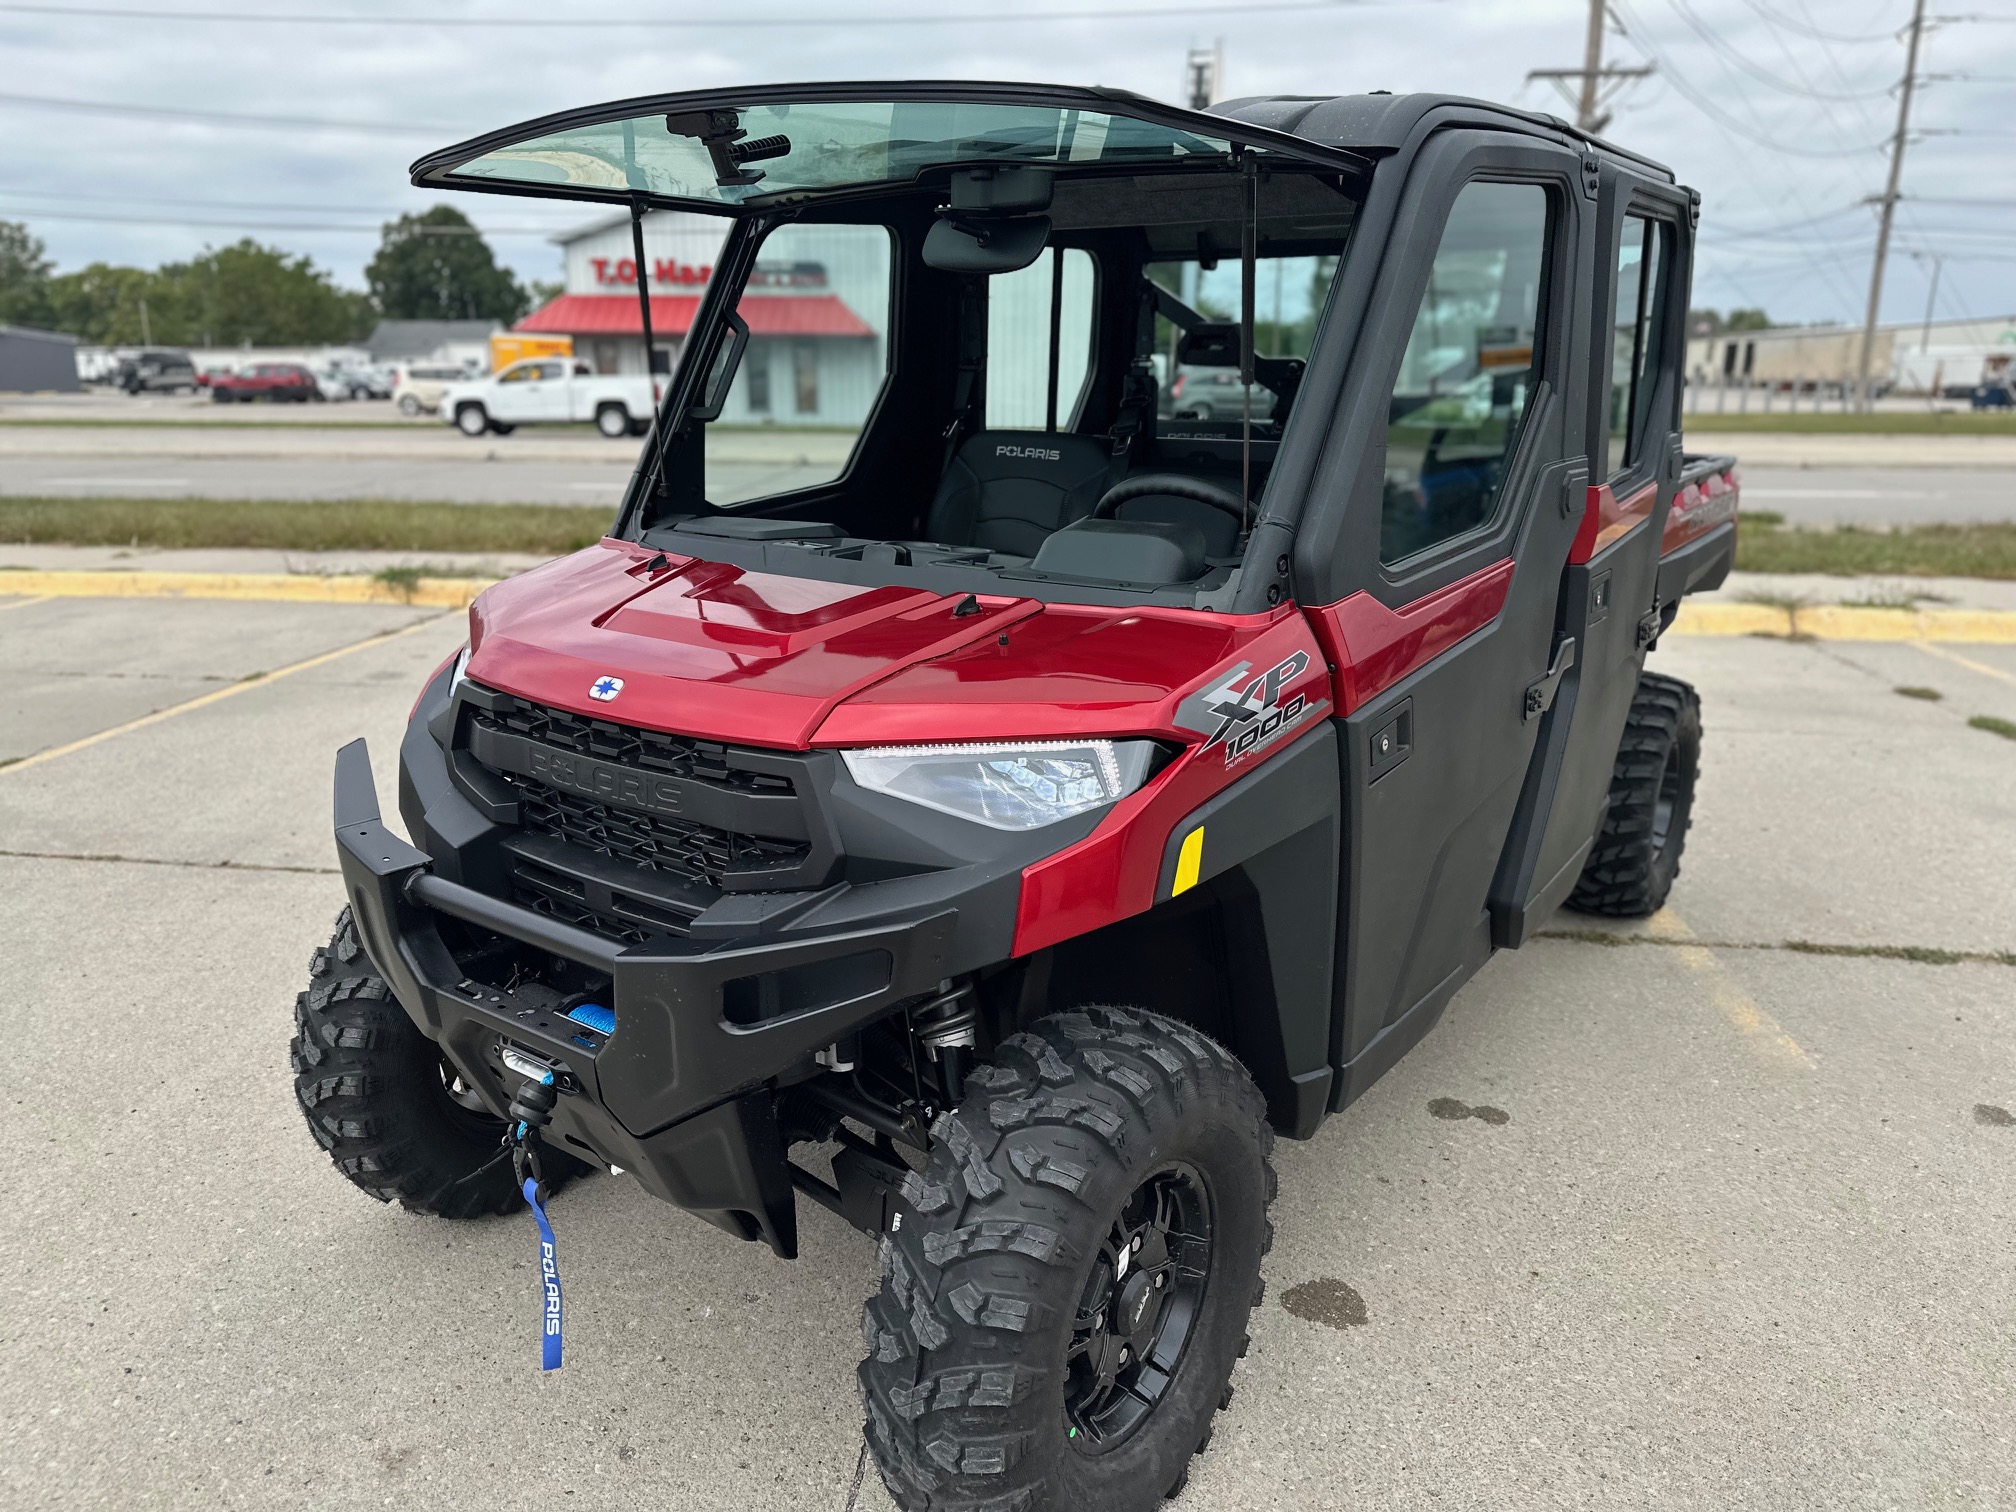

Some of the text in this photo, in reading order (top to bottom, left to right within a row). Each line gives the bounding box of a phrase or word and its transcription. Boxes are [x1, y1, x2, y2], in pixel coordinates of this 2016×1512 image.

[591, 258, 638, 285] T.O
[996, 445, 1060, 461] POLARIS
[1195, 650, 1311, 758] XP
[1225, 693, 1305, 765] 1000
[528, 745, 684, 813] POLARIS
[1225, 755, 1246, 771] DUAL
[542, 1241, 560, 1336] POLARIS
